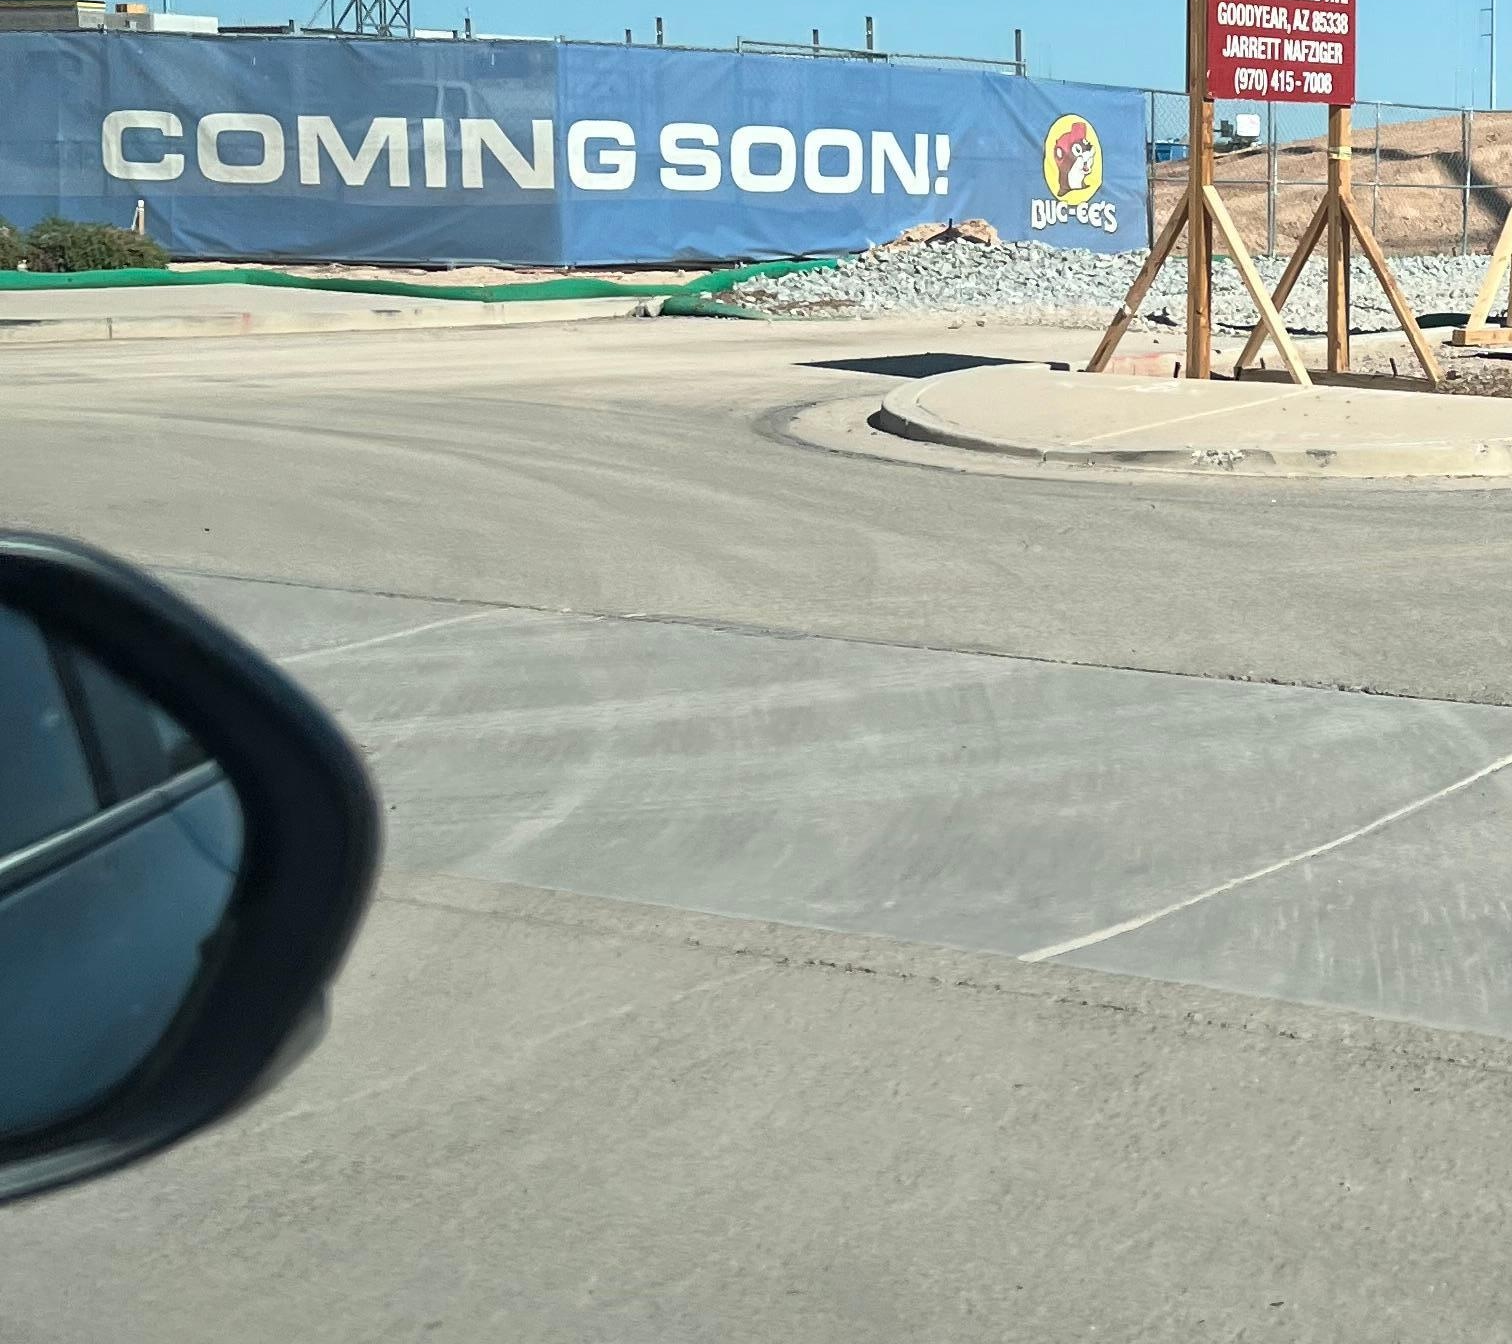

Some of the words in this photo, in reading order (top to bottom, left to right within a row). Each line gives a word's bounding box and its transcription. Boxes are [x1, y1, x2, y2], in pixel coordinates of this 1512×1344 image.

[1217, 1, 1292, 34] GOODYEAR,
[1292, 8, 1310, 31] AZ
[1311, 10, 1349, 34] 85338
[1222, 35, 1281, 60] JARRETT
[1283, 38, 1343, 65] NAFZIGER
[1234, 67, 1268, 96] (970)
[101, 109, 637, 190] COMING
[659, 122, 950, 195] SOON!
